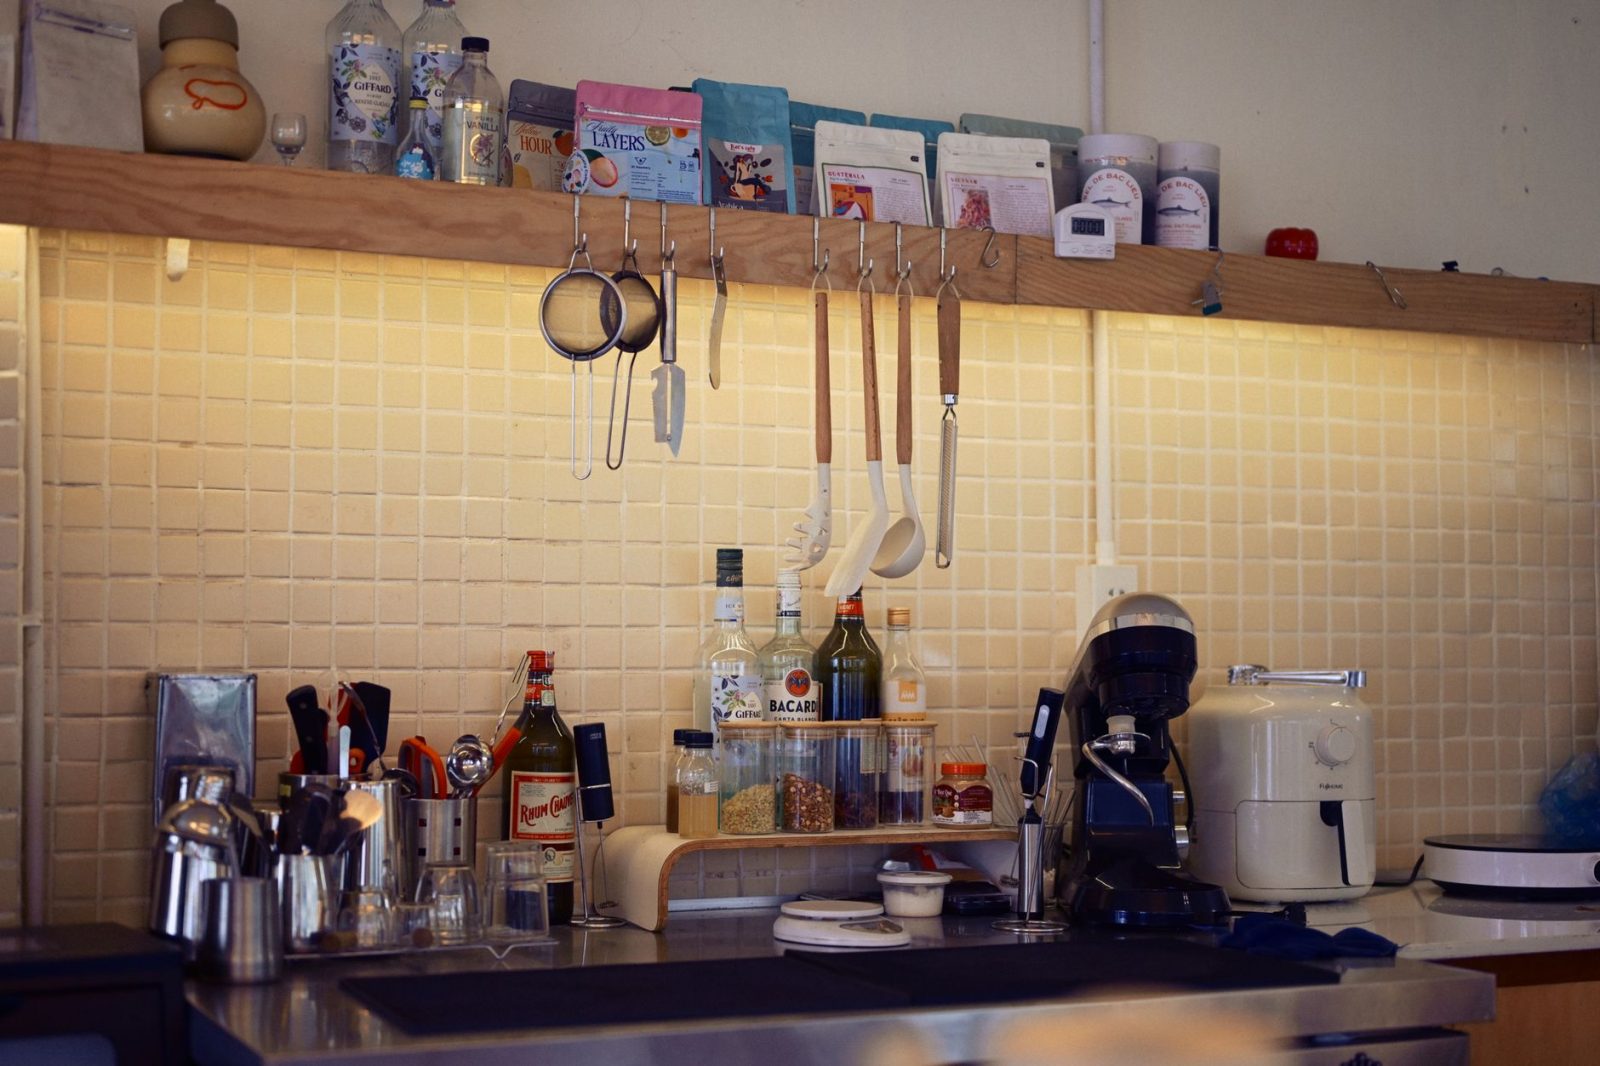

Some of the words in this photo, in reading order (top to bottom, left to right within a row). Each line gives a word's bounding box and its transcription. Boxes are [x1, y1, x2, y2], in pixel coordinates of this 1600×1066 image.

[354, 81, 392, 94] GIFFARD
[520, 135, 552, 155] HOUR
[593, 131, 646, 152] LAYERS
[1092, 174, 1104, 185] DE
[1106, 172, 1125, 182] BAC
[1125, 180, 1140, 200] LIEU
[1175, 181, 1194, 190] BAC
[1194, 188, 1208, 208] LIEU
[520, 804, 549, 827] RHUM
